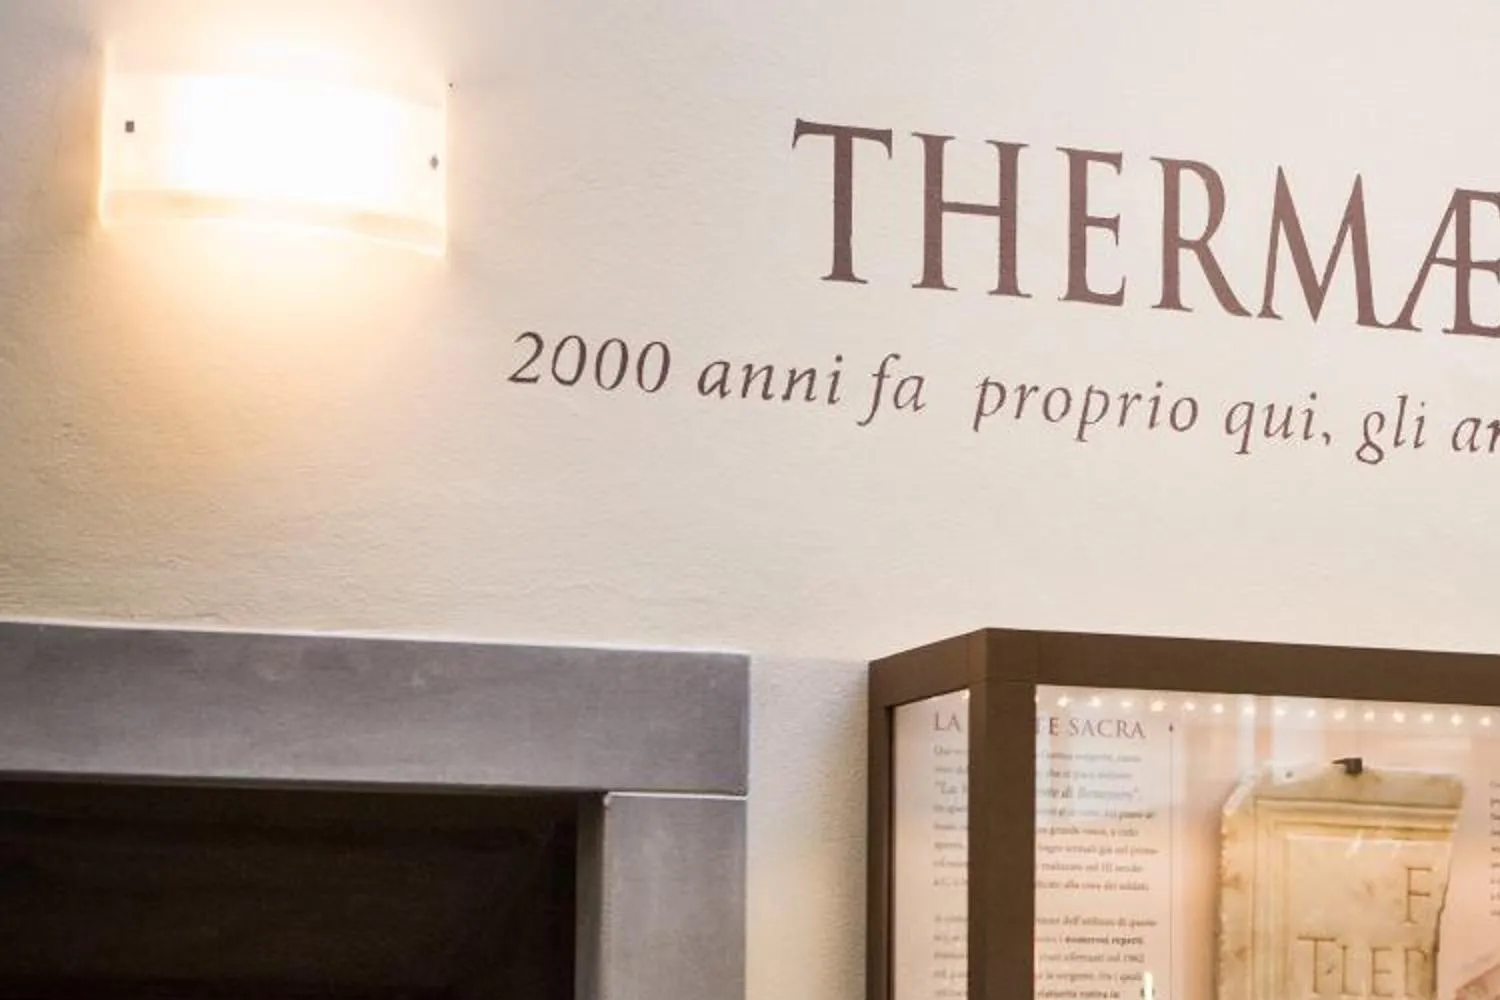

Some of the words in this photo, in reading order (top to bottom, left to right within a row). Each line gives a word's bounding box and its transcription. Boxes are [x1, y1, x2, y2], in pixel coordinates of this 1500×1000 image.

[506, 330, 671, 394] 2000
[696, 353, 844, 406] anni
[855, 352, 927, 427] fa
[972, 375, 1199, 443] proprio
[1224, 388, 1332, 456] qui,
[1354, 390, 1425, 466] gli
[1069, 718, 1146, 739] SACRA
